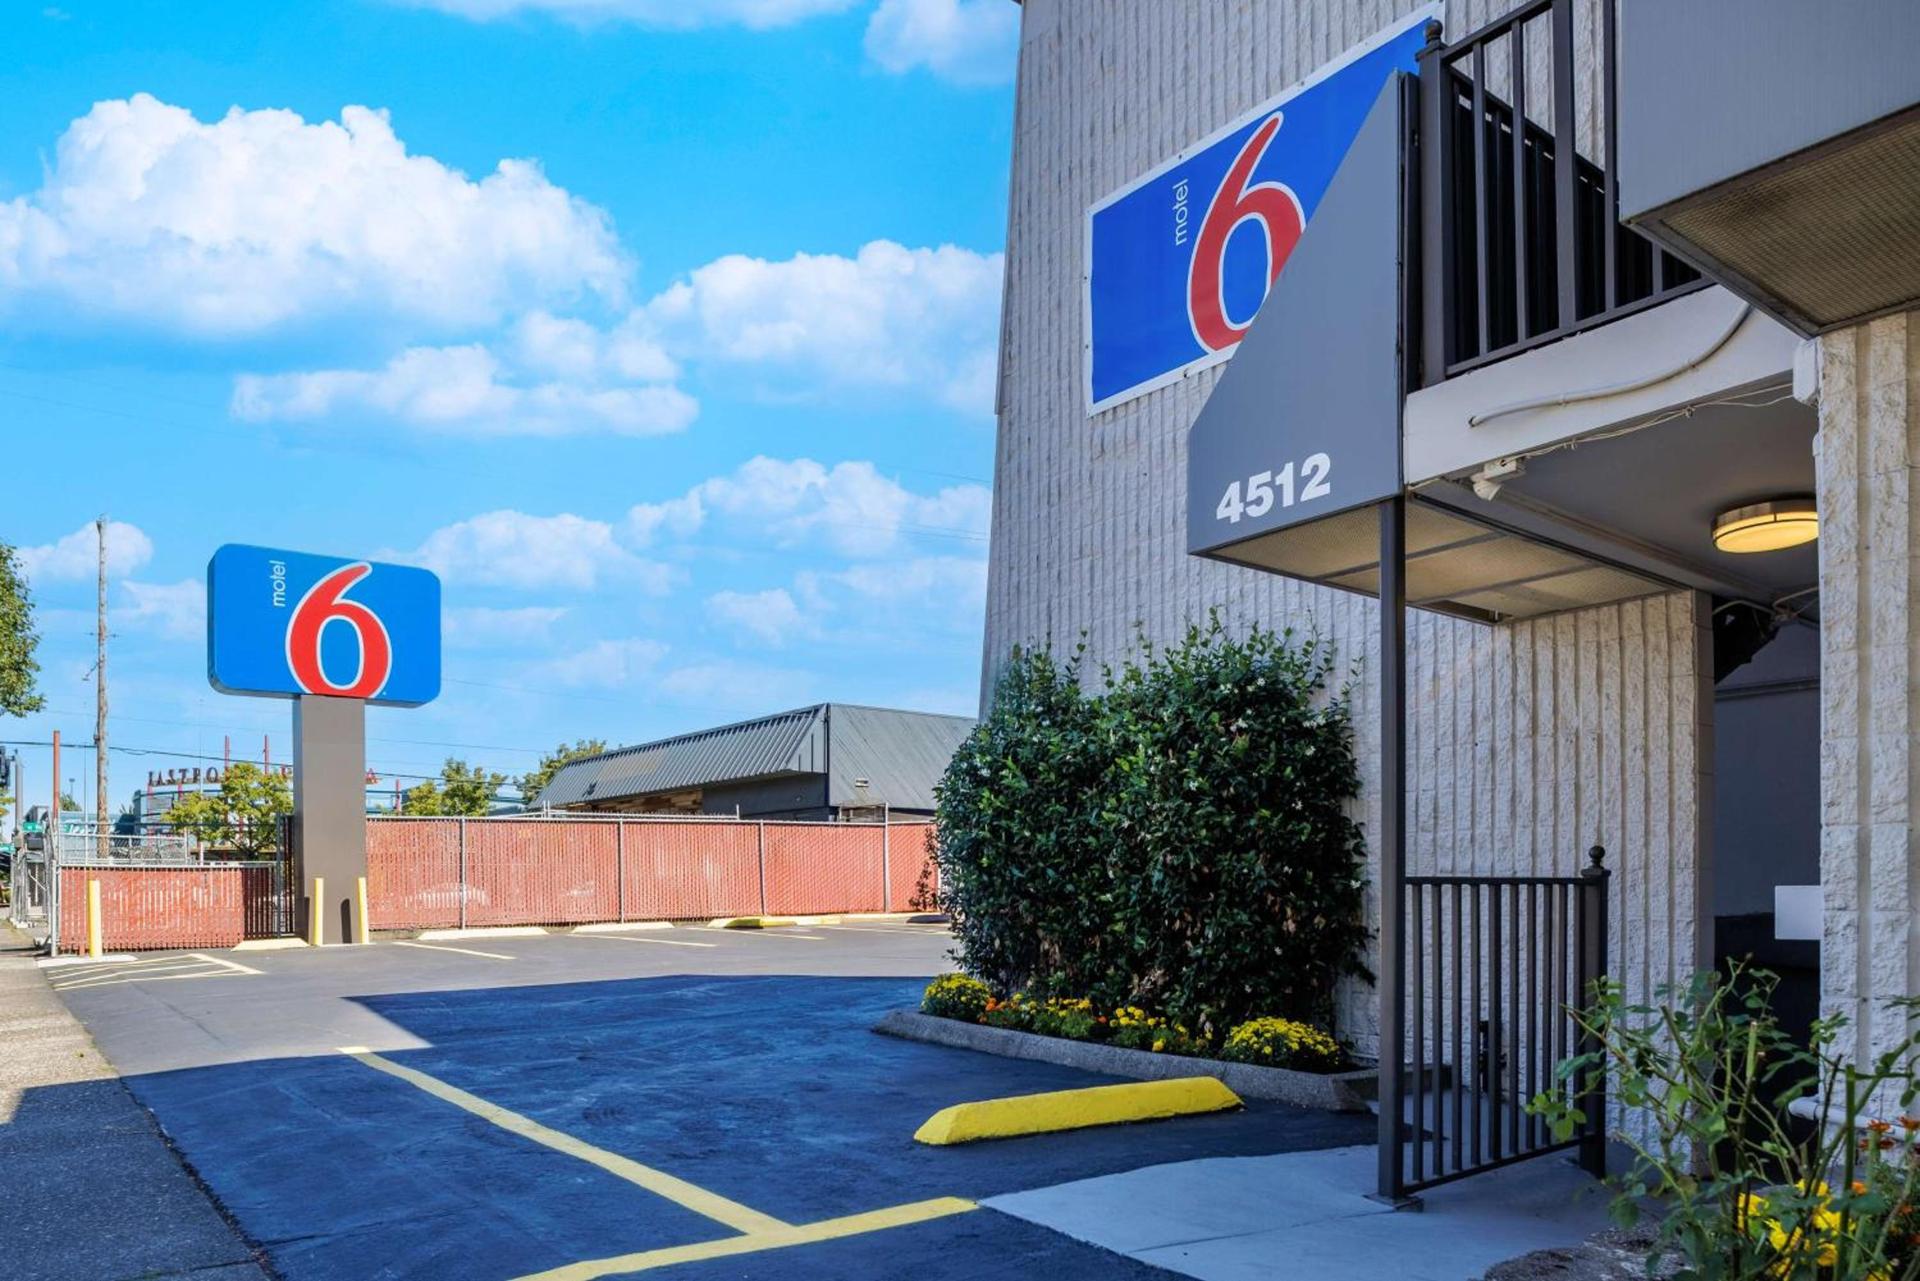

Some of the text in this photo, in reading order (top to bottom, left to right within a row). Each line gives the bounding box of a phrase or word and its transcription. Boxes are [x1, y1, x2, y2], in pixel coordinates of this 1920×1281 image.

[1172, 110, 1307, 355] motel 6
[1216, 452, 1331, 524] 4512
[269, 560, 393, 699] motel 6
